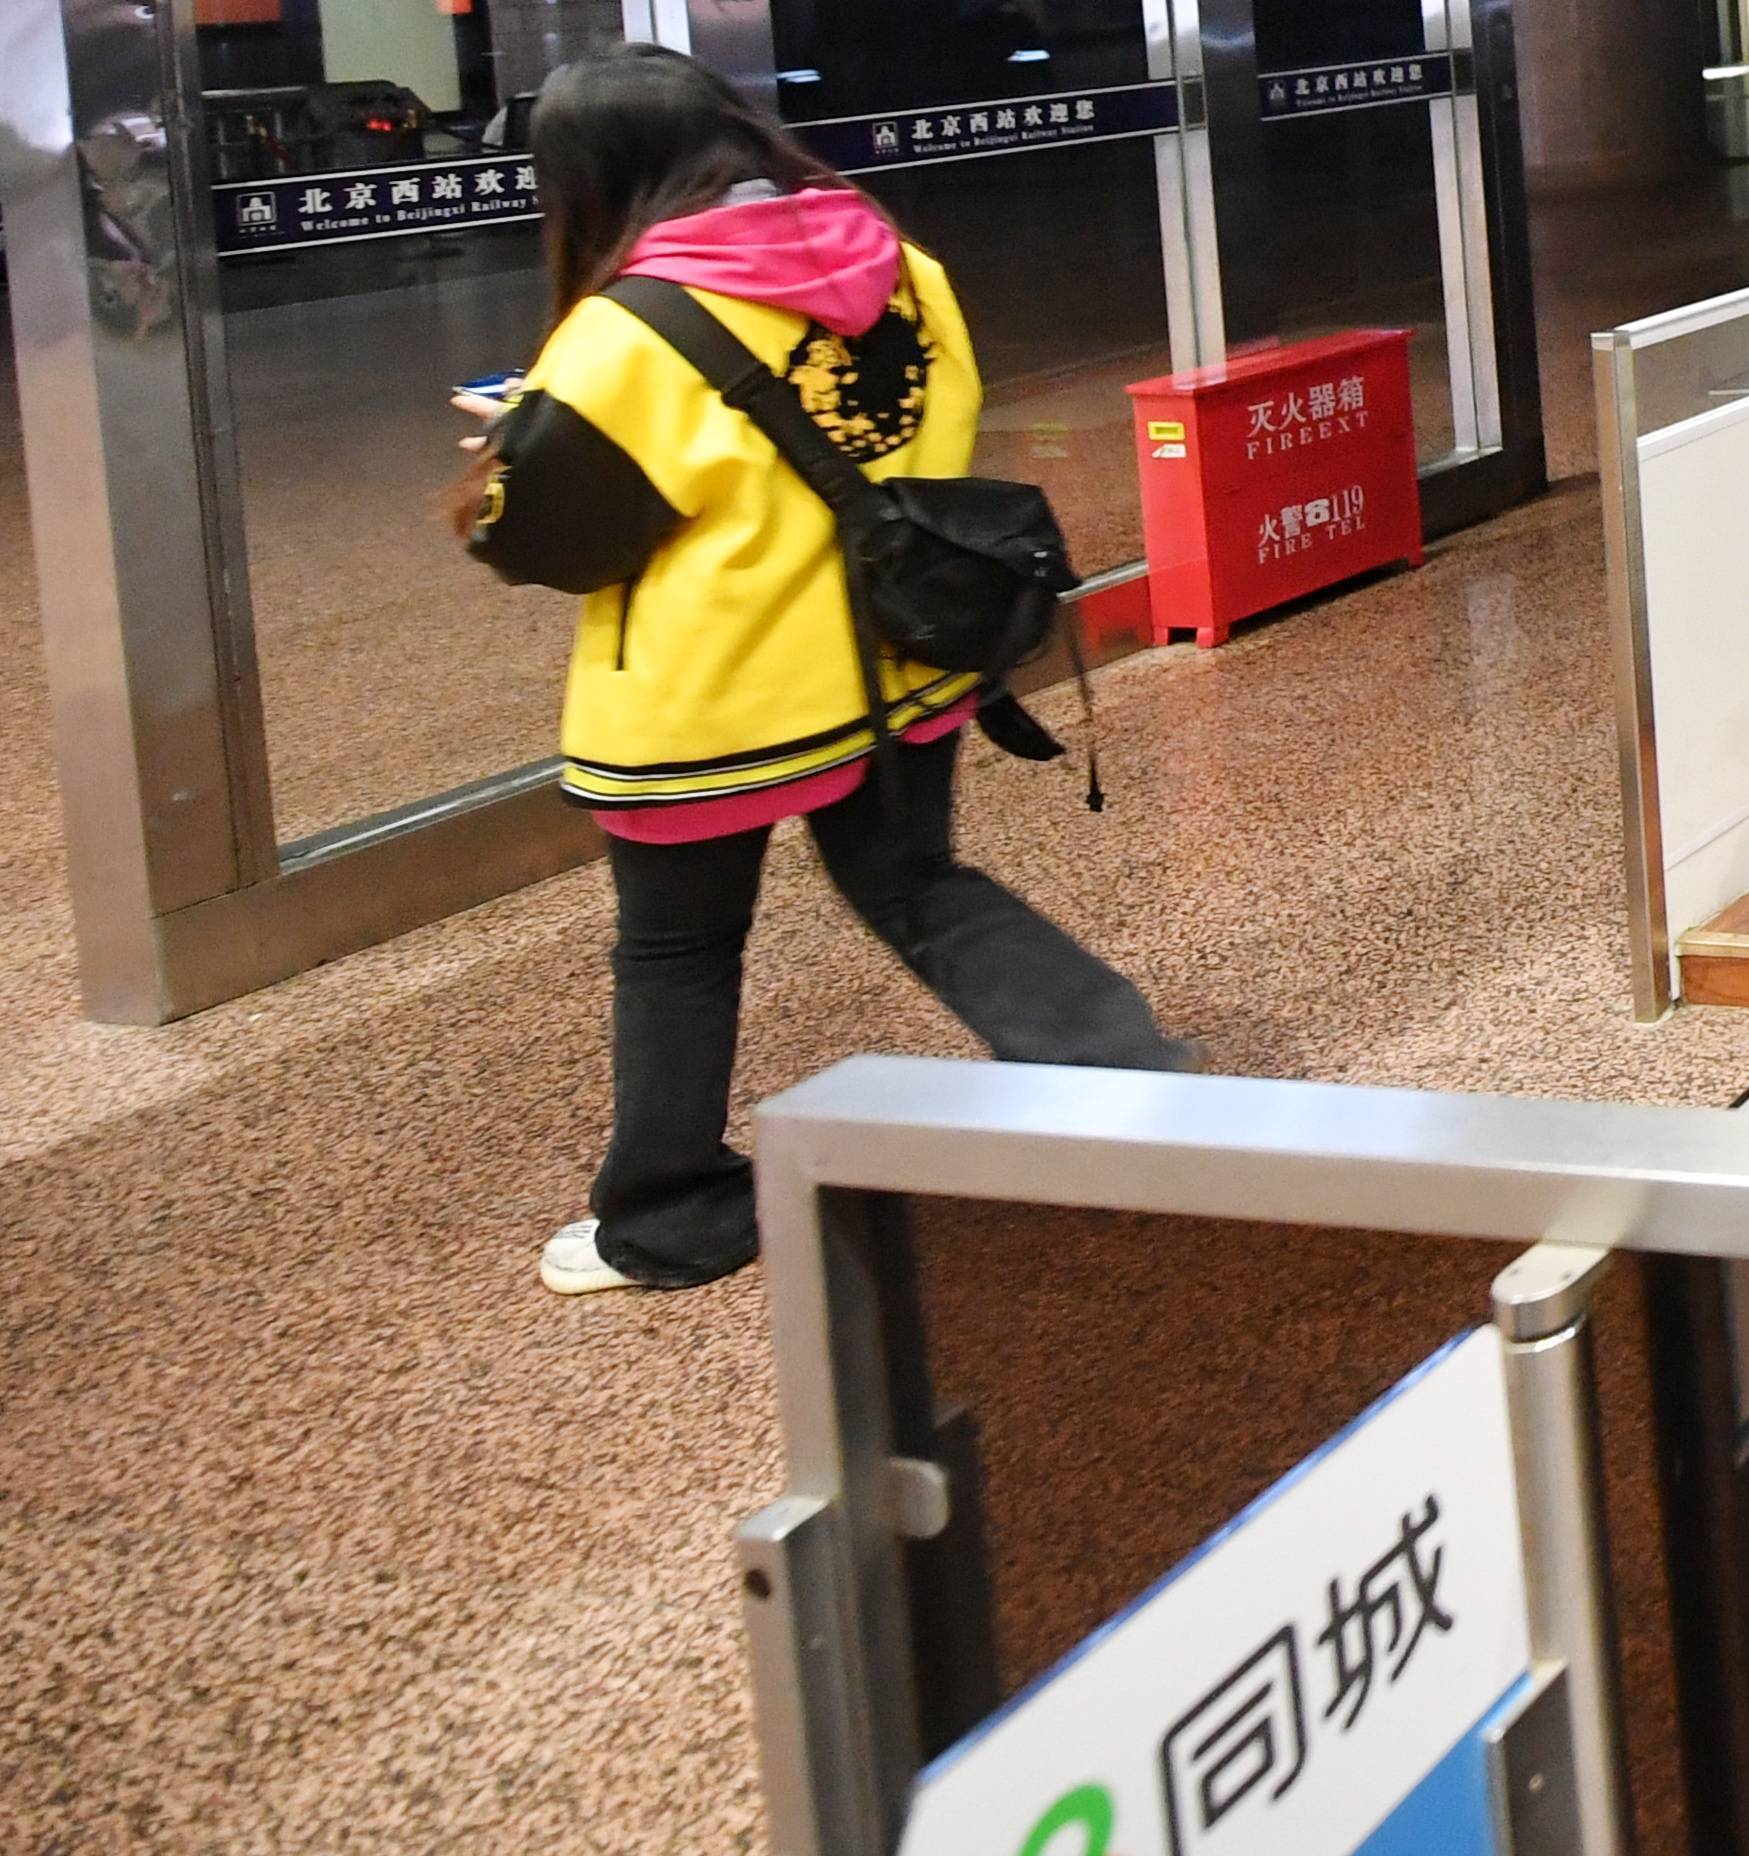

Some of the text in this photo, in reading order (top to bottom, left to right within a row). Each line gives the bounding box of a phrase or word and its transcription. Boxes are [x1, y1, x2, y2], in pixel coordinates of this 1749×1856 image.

[1294, 63, 1423, 96] 北京西站欢迎您
[910, 99, 1096, 141] 北京西站欢迎您
[300, 214, 370, 233] Welcome
[375, 212, 391, 225] to
[397, 203, 466, 225] Beijingxi
[471, 196, 528, 216] Railway
[1247, 376, 1365, 438] 灭火器箱
[1258, 515, 1366, 565] FIRE TEL
[1018, 1494, 1455, 1856] 同城
